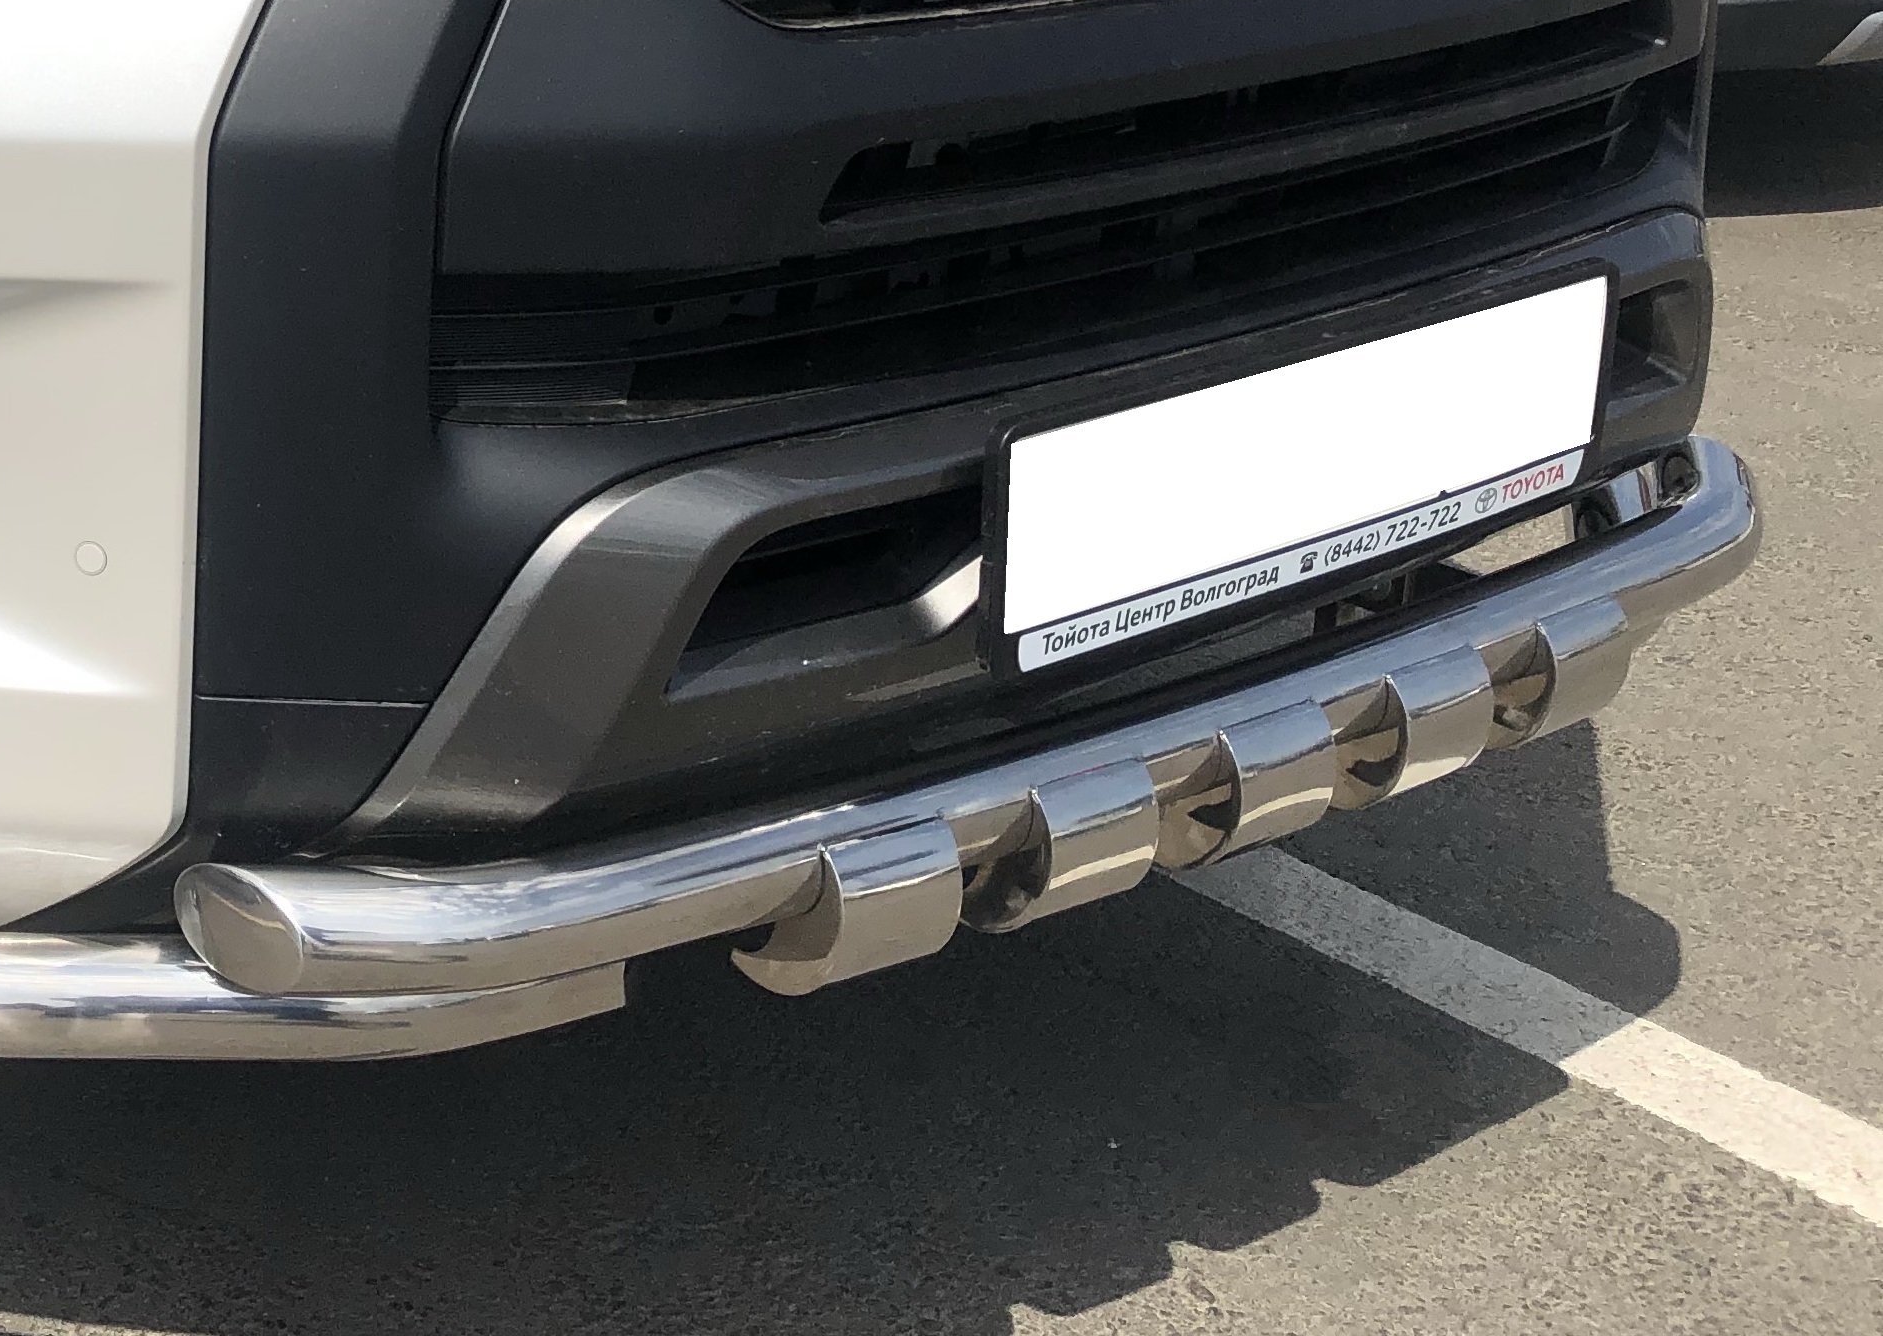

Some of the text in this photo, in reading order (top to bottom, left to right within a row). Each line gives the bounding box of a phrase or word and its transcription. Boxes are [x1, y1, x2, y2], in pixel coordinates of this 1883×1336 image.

[1042, 462, 1565, 655] Тойота Центр Волгоград (8442) 722-722 TOYOTA
